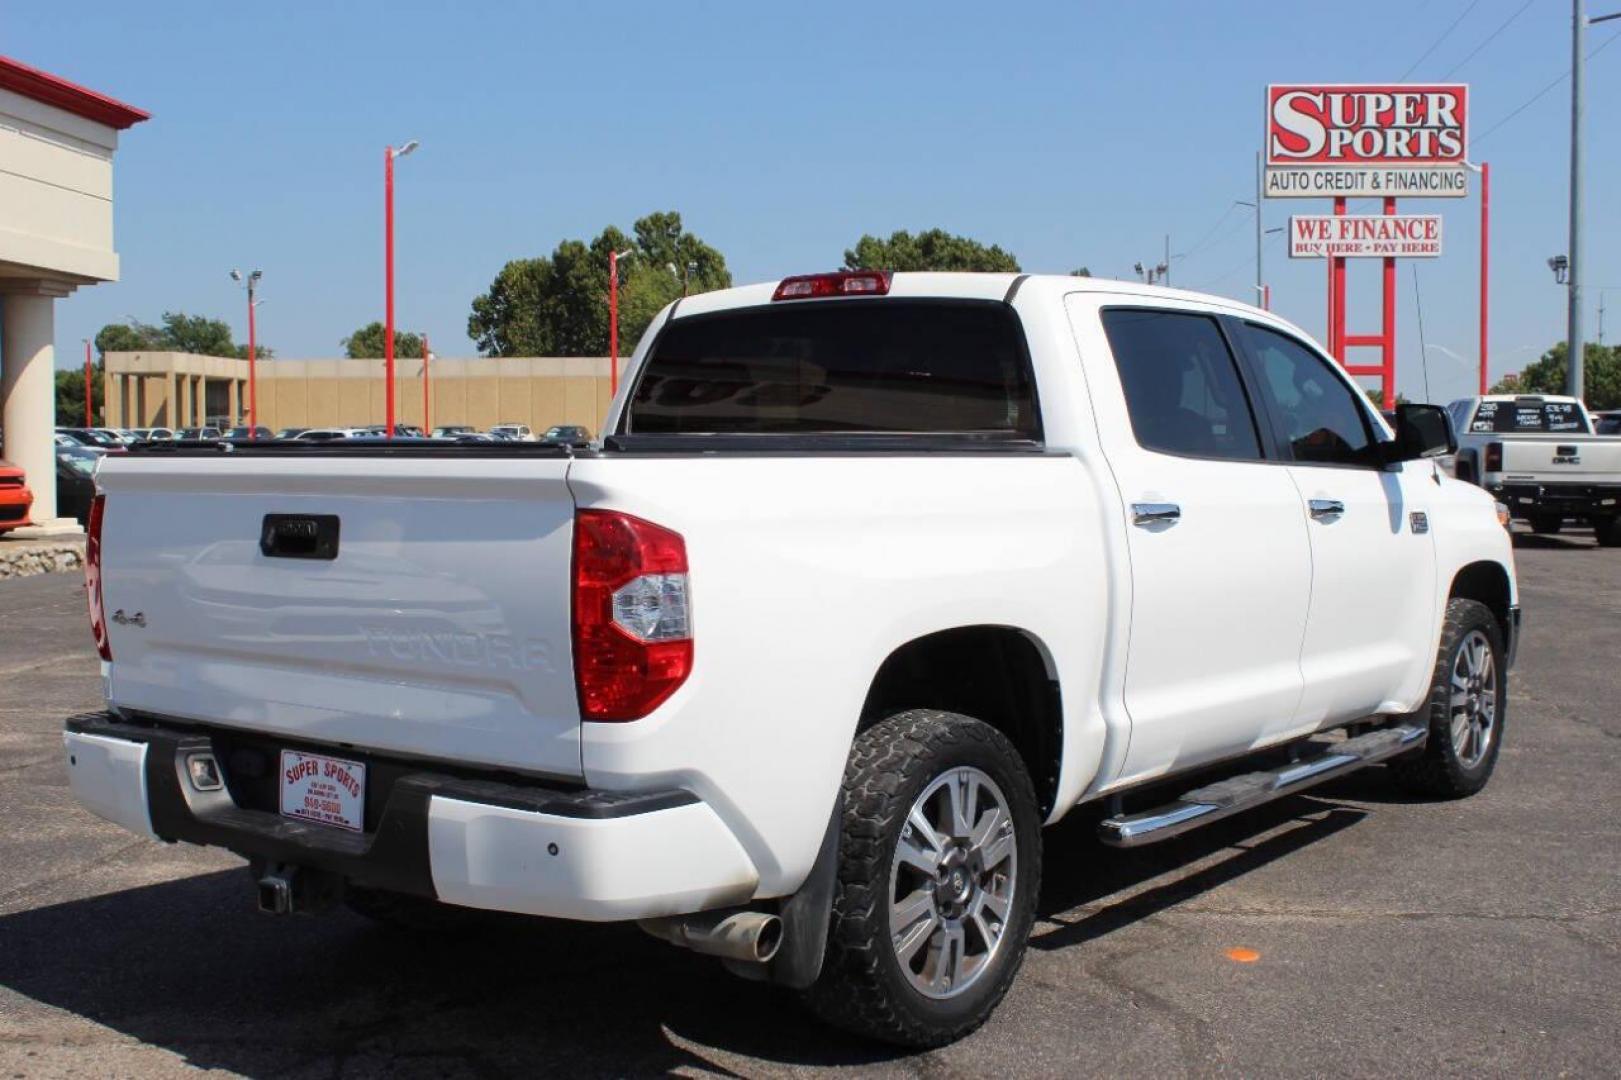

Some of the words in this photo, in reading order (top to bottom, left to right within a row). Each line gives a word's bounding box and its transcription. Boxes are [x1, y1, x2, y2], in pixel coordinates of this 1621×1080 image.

[1269, 172, 1309, 190] AUTO
[1314, 172, 1367, 190] CREDIT
[1371, 172, 1381, 190] &
[1386, 172, 1465, 190] FINANCING
[1296, 219, 1332, 240] WE
[1340, 219, 1438, 240] FINANCE
[1295, 243, 1322, 253] BUY
[1326, 243, 1362, 253] HERE
[1374, 243, 1395, 253] PAY
[1402, 243, 1439, 253] HERE
[1552, 457, 1581, 465] GMC
[286, 760, 319, 785] SUPER
[324, 761, 360, 798] SPORTS
